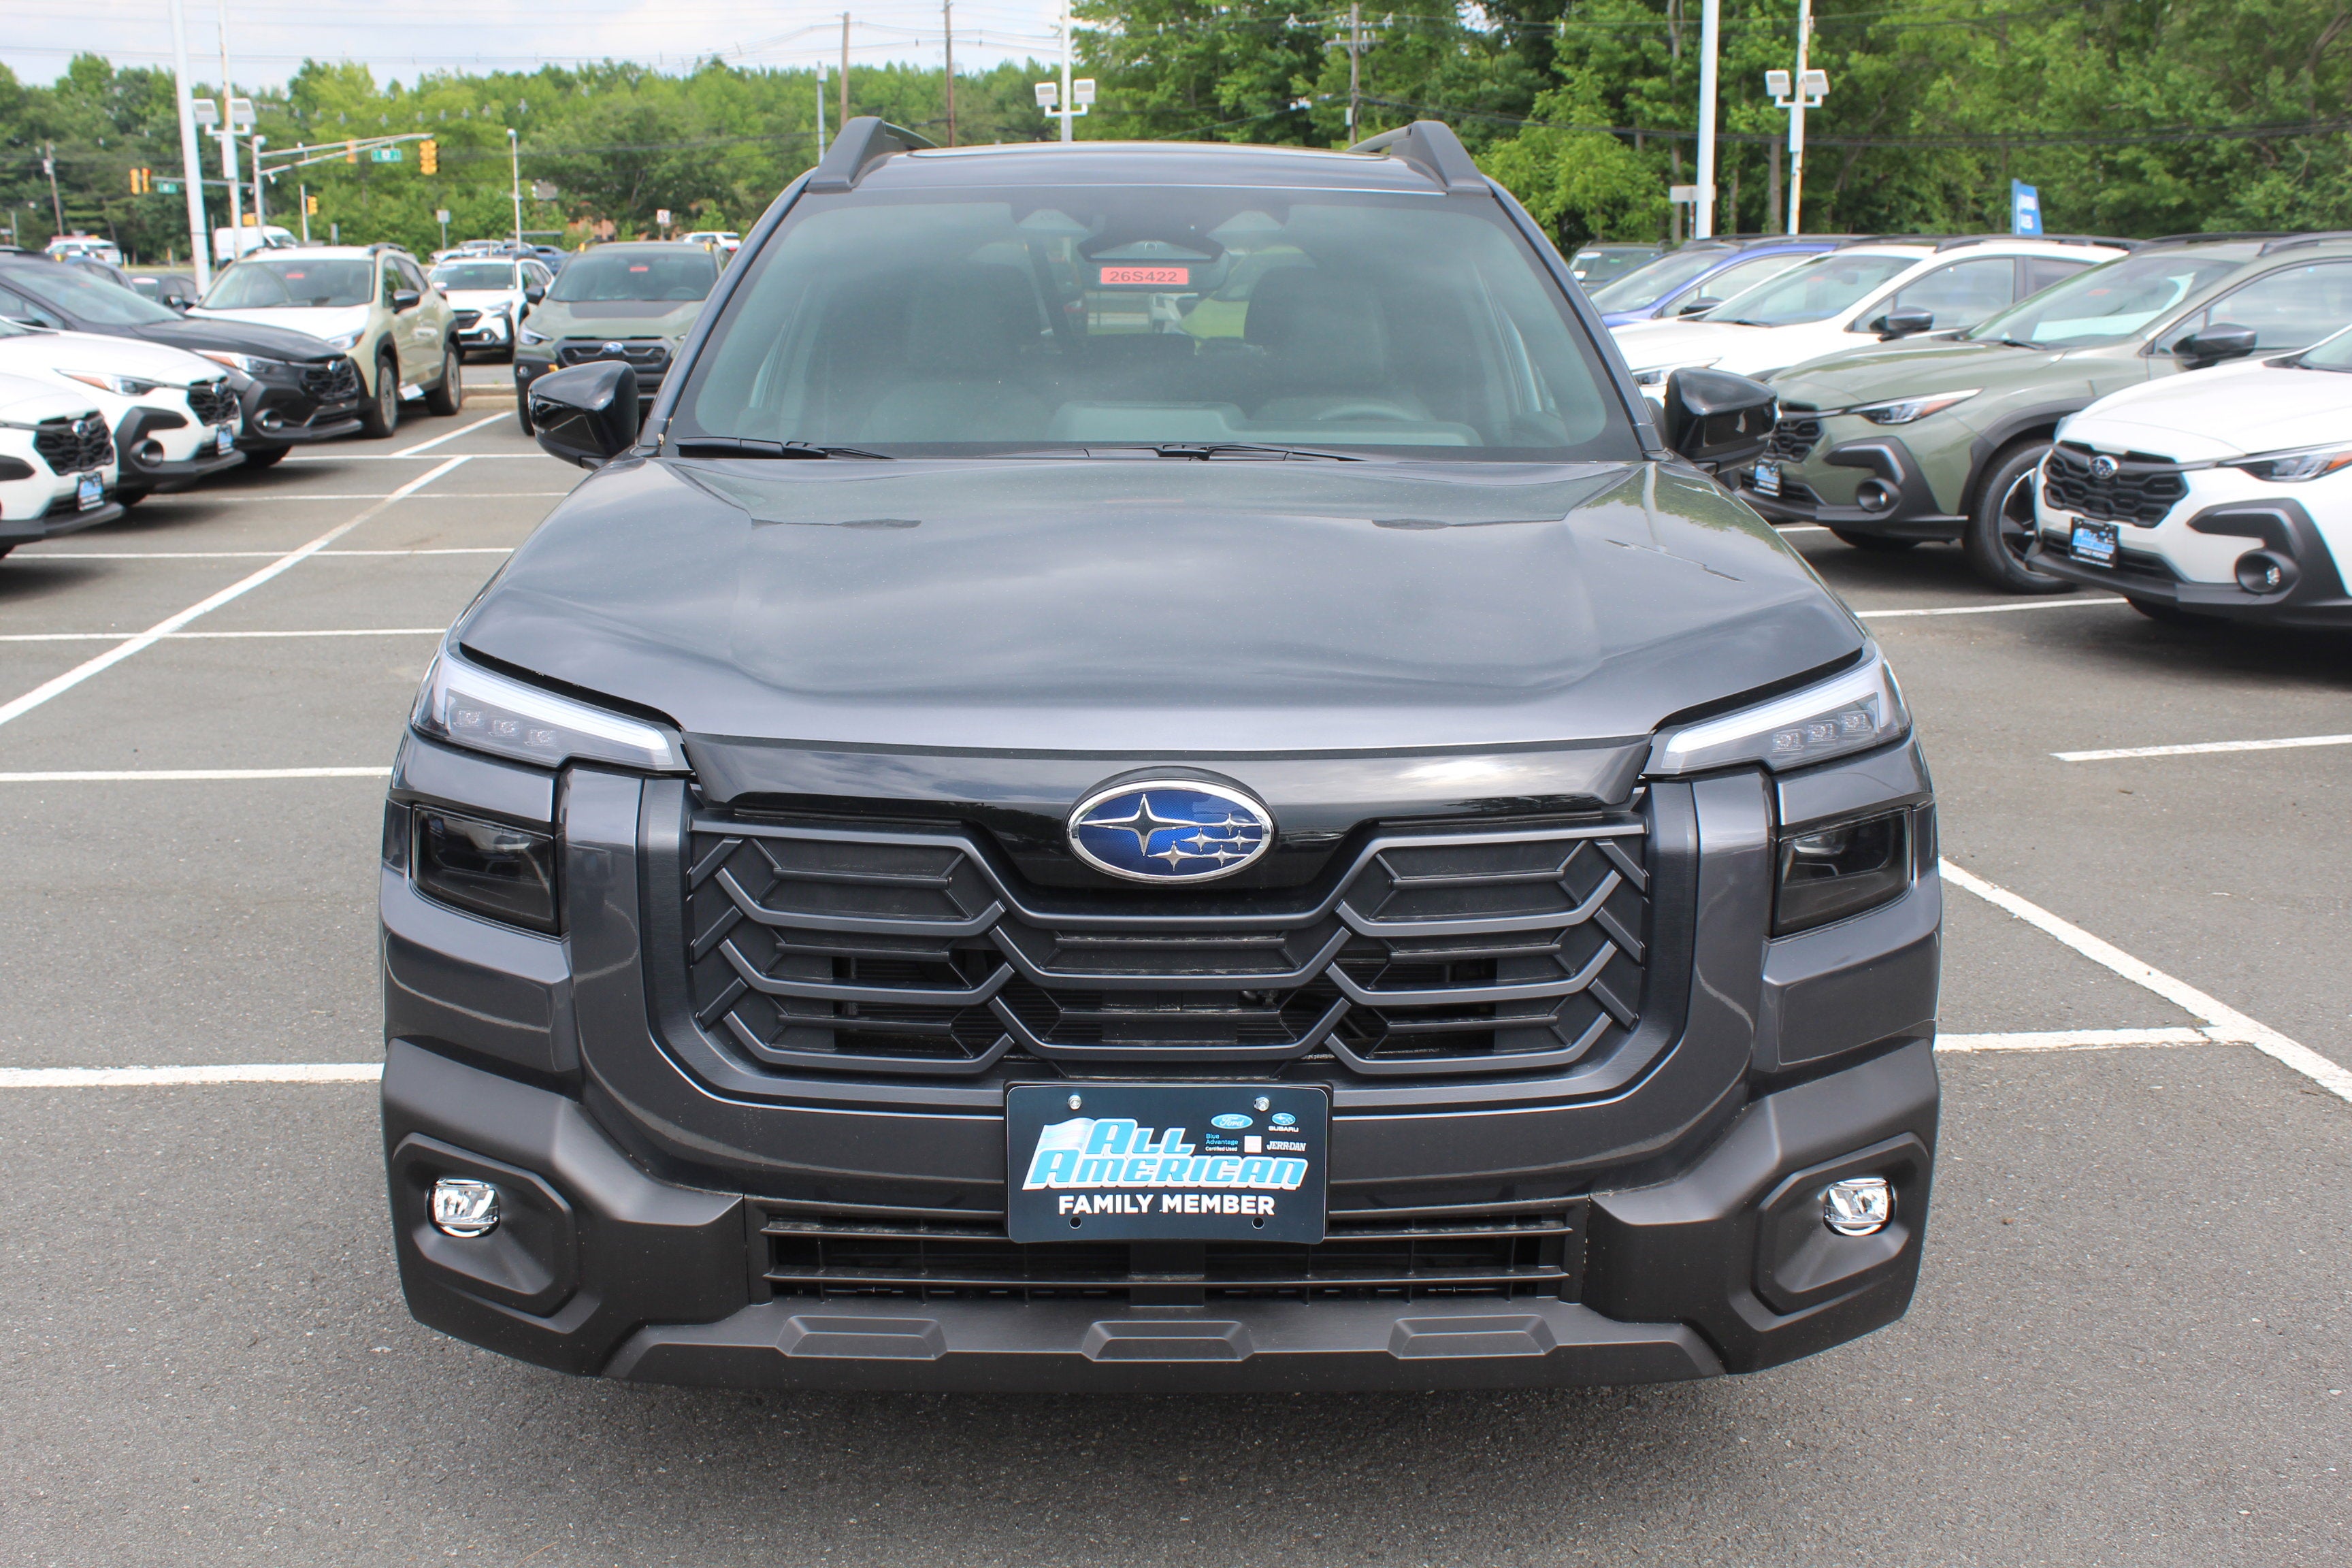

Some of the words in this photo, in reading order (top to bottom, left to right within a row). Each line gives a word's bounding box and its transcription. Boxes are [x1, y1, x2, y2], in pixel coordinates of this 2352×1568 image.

[1109, 271, 1177, 282] 26S422
[1219, 1115, 1245, 1127] Ford
[1022, 1149, 1309, 1190] AMERICAN
[1058, 1194, 1154, 1215] FAMILY
[1162, 1194, 1275, 1215] MEMBER
